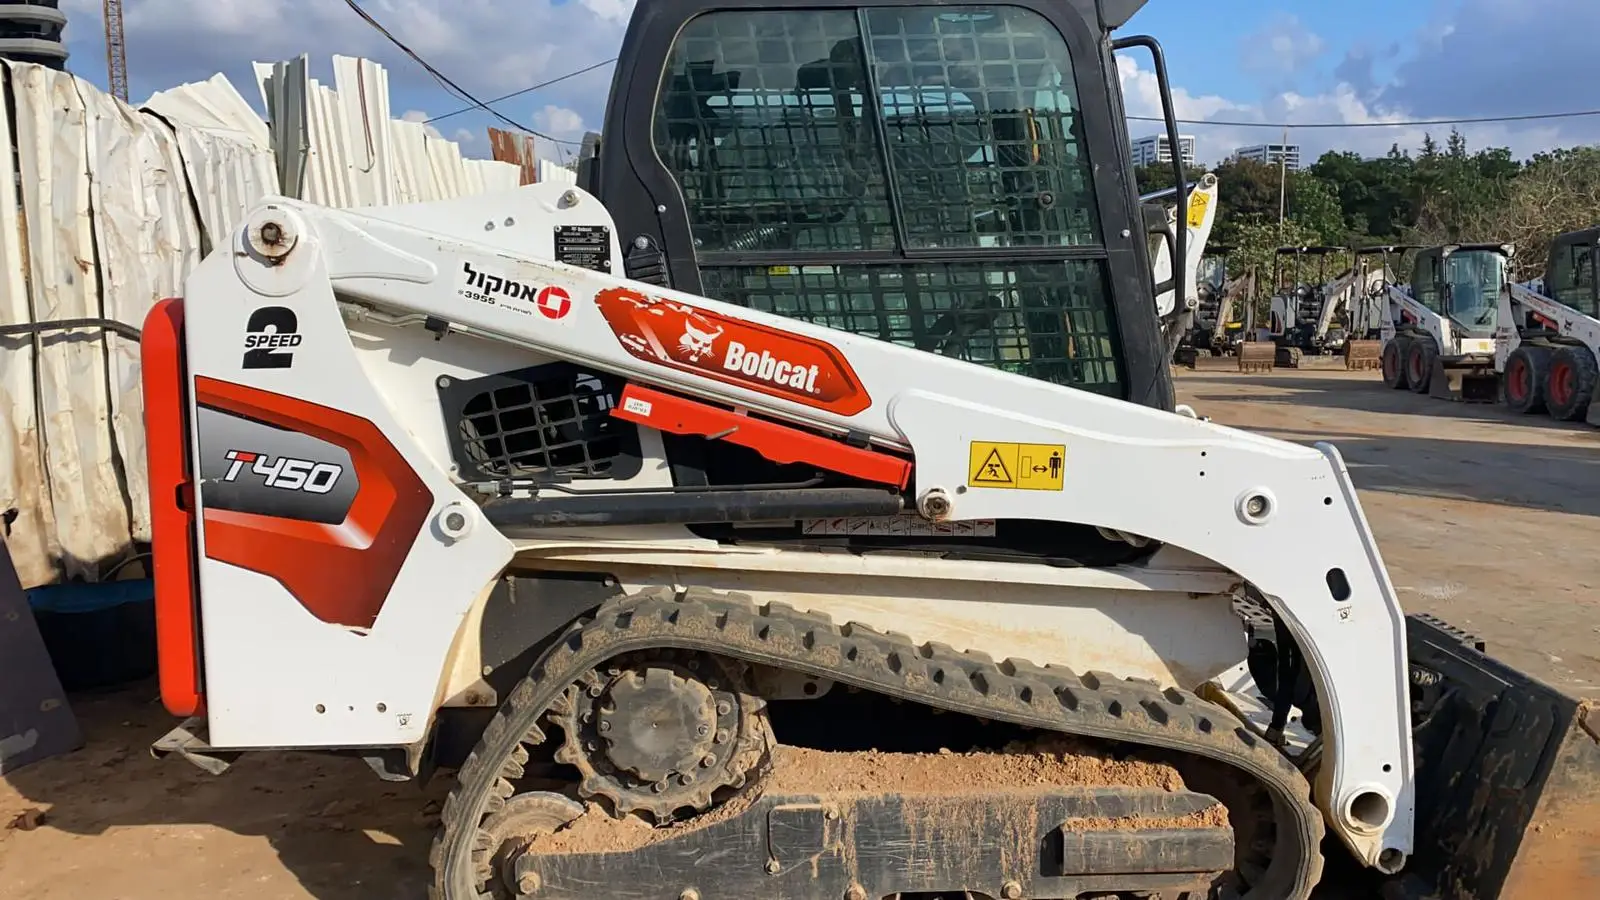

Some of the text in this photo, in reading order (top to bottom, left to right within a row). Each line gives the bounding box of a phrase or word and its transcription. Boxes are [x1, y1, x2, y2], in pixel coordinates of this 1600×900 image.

[464, 262, 537, 303] אמקול
[242, 306, 298, 369] 2
[244, 334, 302, 348] SPEED
[723, 340, 820, 394] Bobcat
[224, 450, 343, 494] T450
